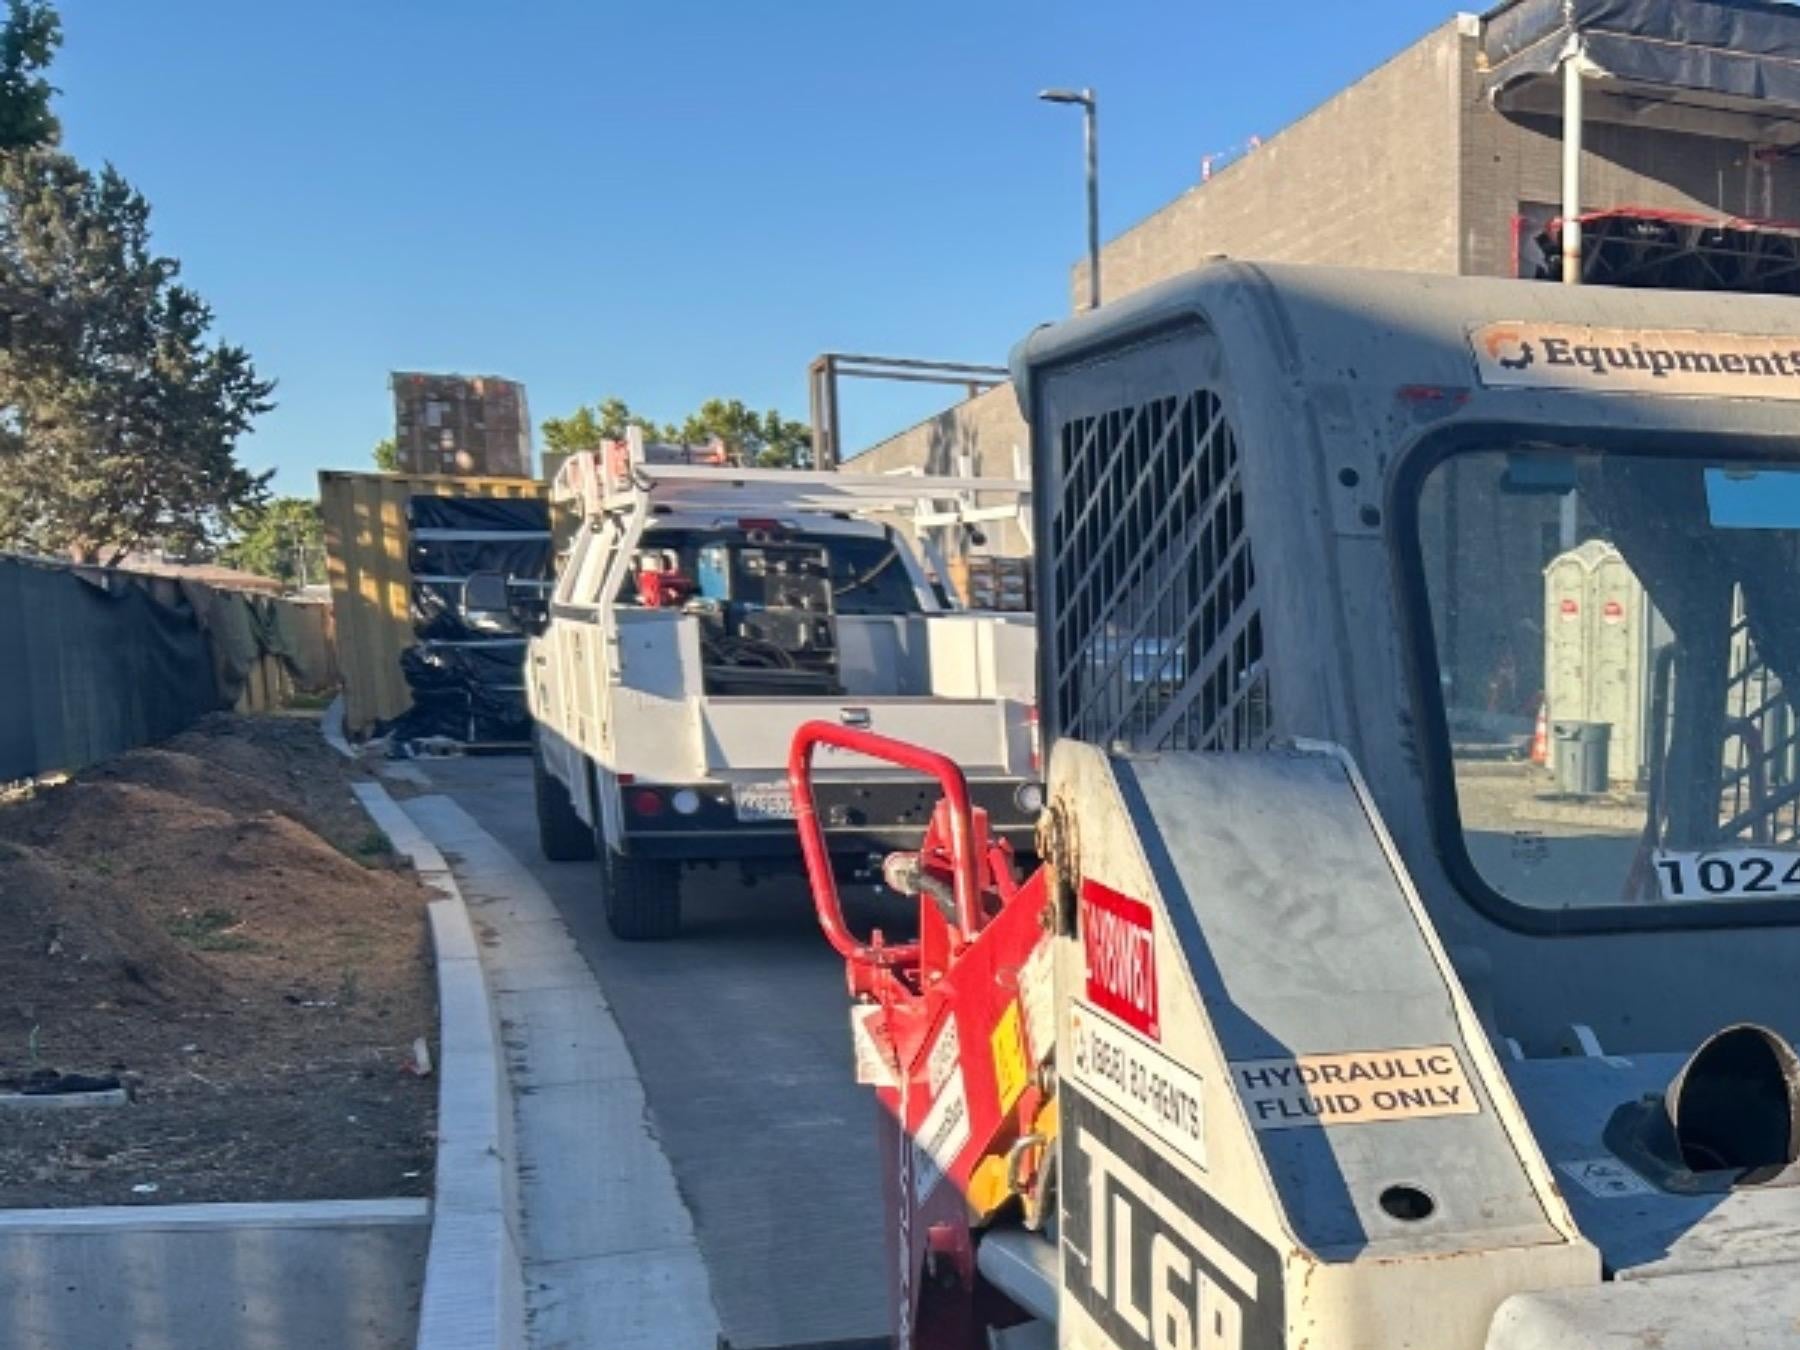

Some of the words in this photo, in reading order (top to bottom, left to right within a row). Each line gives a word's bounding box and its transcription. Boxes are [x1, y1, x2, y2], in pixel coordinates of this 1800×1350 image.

[1241, 1055, 1453, 1090] HYDRAULIC
[1254, 1093, 1361, 1120] FLUID
[1371, 1084, 1461, 1111] ONLY
